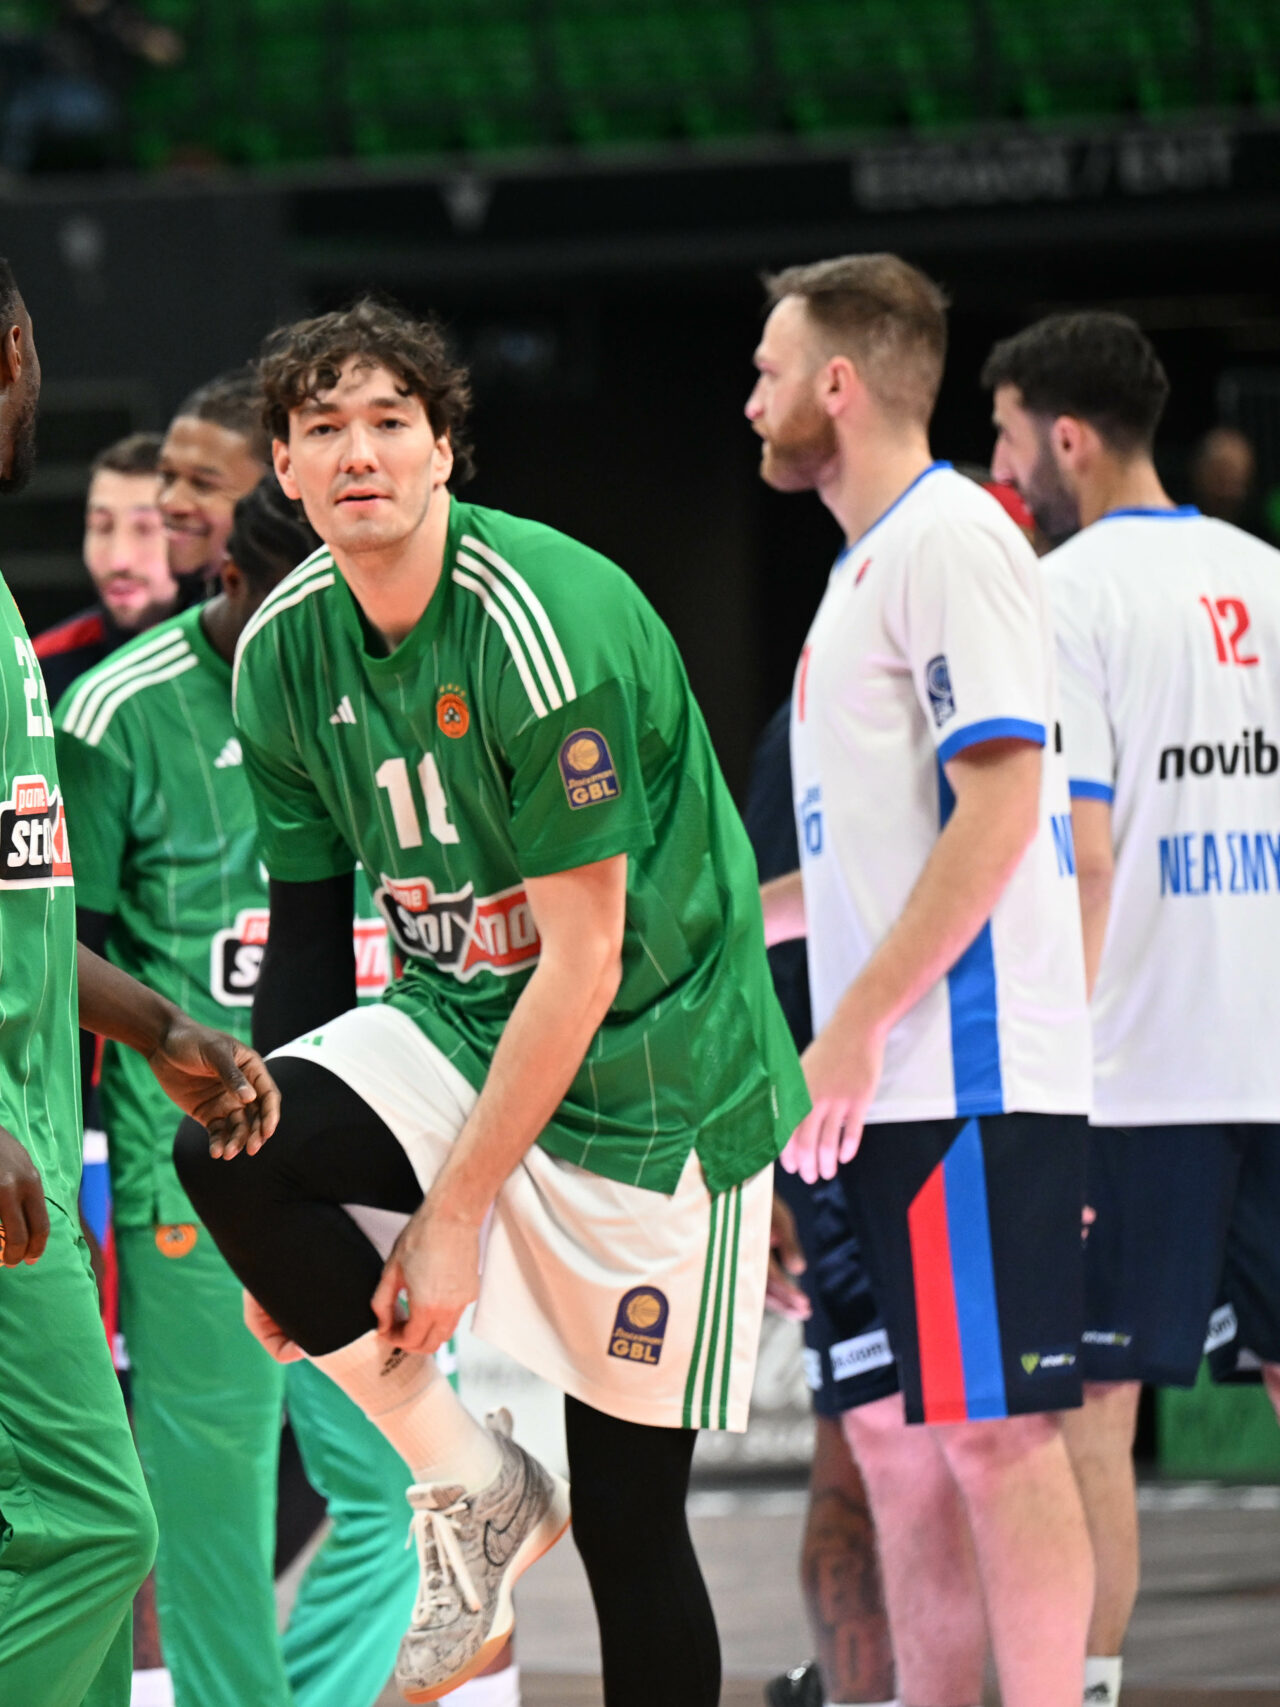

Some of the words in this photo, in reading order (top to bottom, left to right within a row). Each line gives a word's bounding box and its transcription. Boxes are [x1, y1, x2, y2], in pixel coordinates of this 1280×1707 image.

[1199, 595, 1261, 667] 12
[1159, 728, 1279, 780] novib
[572, 779, 617, 804] GBL
[612, 1339, 657, 1363] GBL
